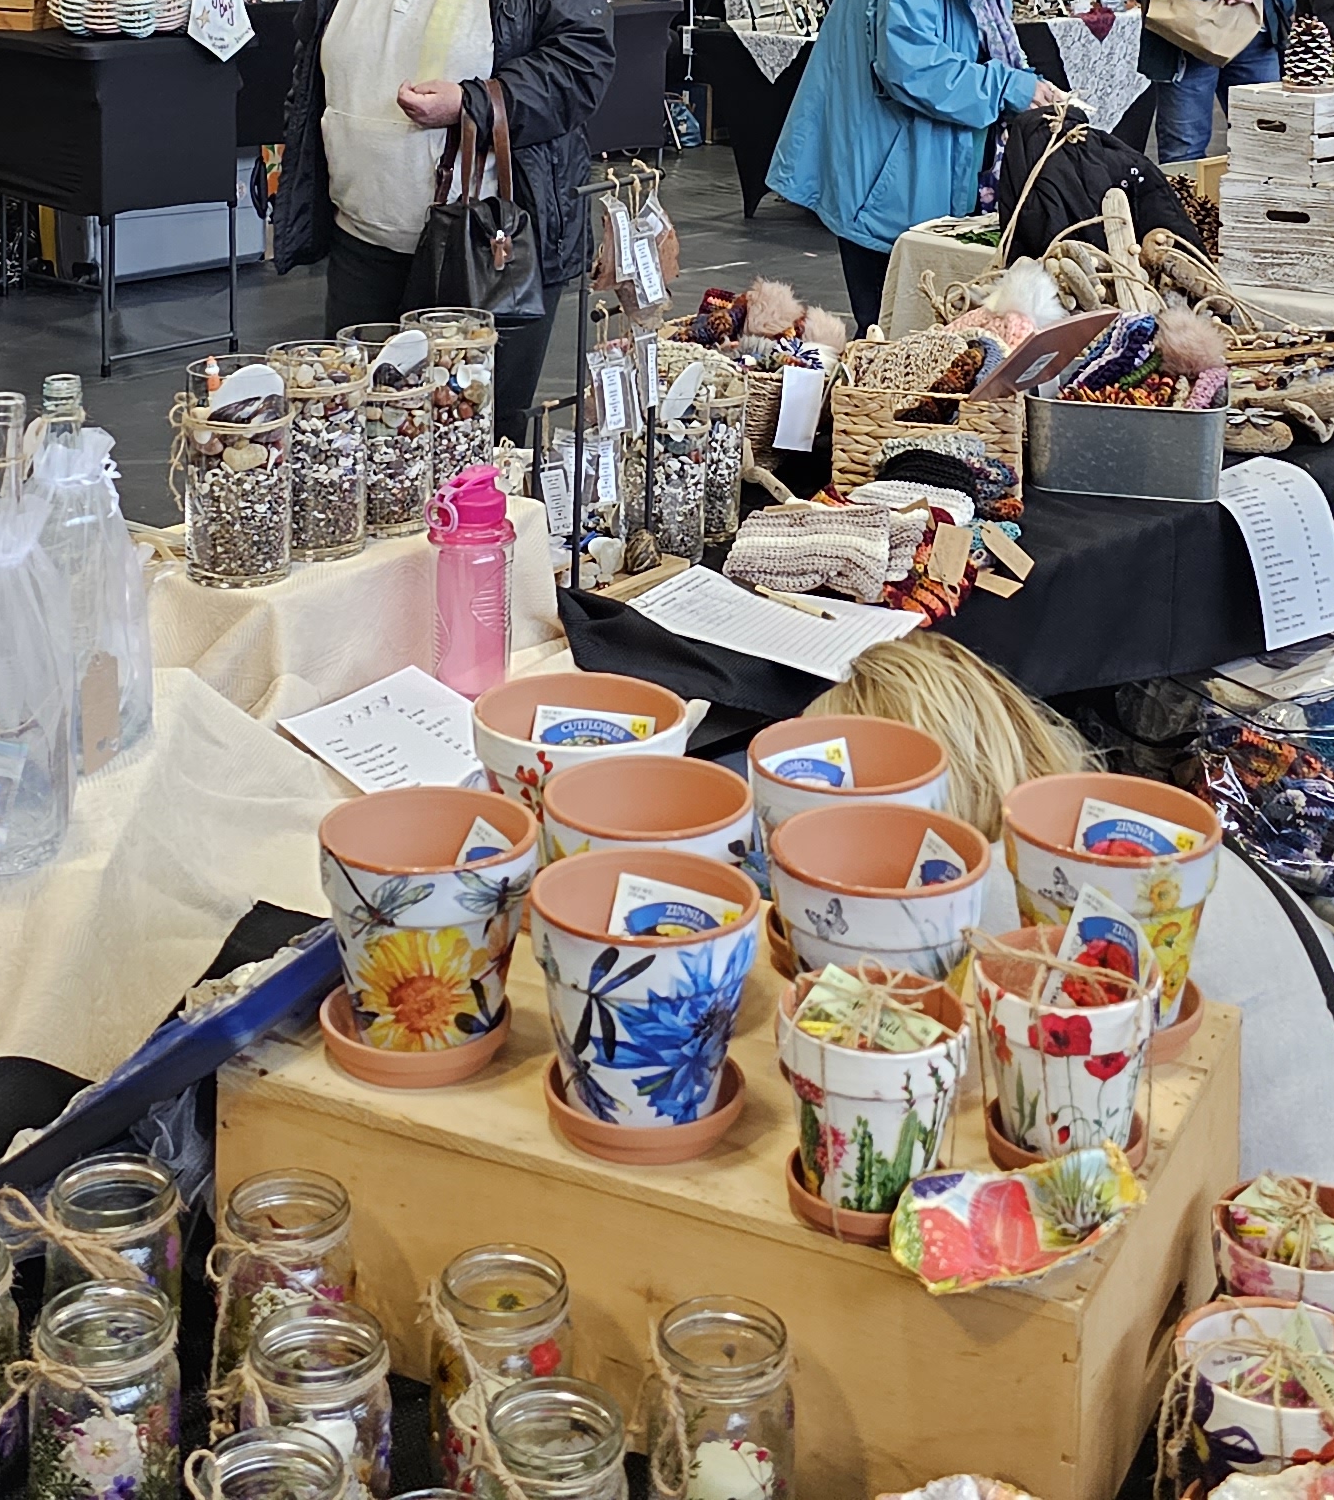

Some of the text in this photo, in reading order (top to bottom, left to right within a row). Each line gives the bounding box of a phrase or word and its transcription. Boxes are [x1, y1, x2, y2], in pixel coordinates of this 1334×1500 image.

[560, 719, 626, 740] CUTFLOWER
[1115, 820, 1155, 842] ZINNIA
[665, 904, 706, 926] ZINNIA
